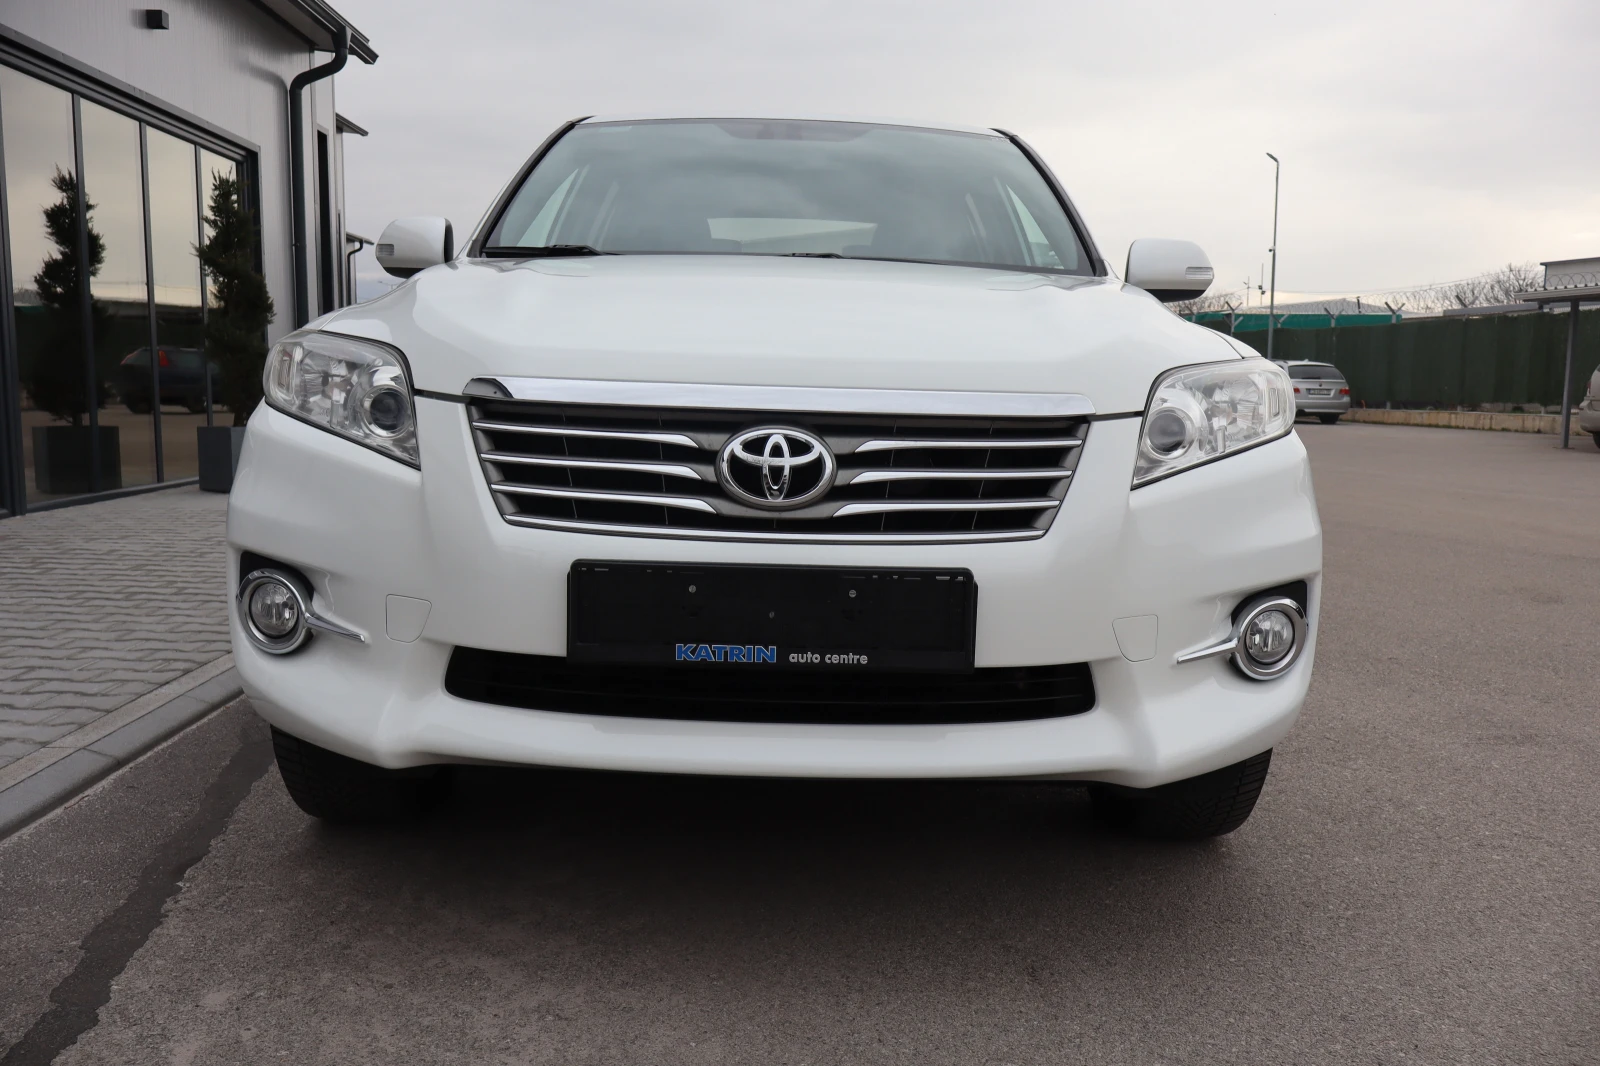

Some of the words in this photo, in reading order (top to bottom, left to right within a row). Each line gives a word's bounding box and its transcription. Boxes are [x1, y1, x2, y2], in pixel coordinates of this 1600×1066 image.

[675, 643, 777, 663] KATRIN
[789, 652, 821, 664] auto
[825, 652, 868, 665] centre
